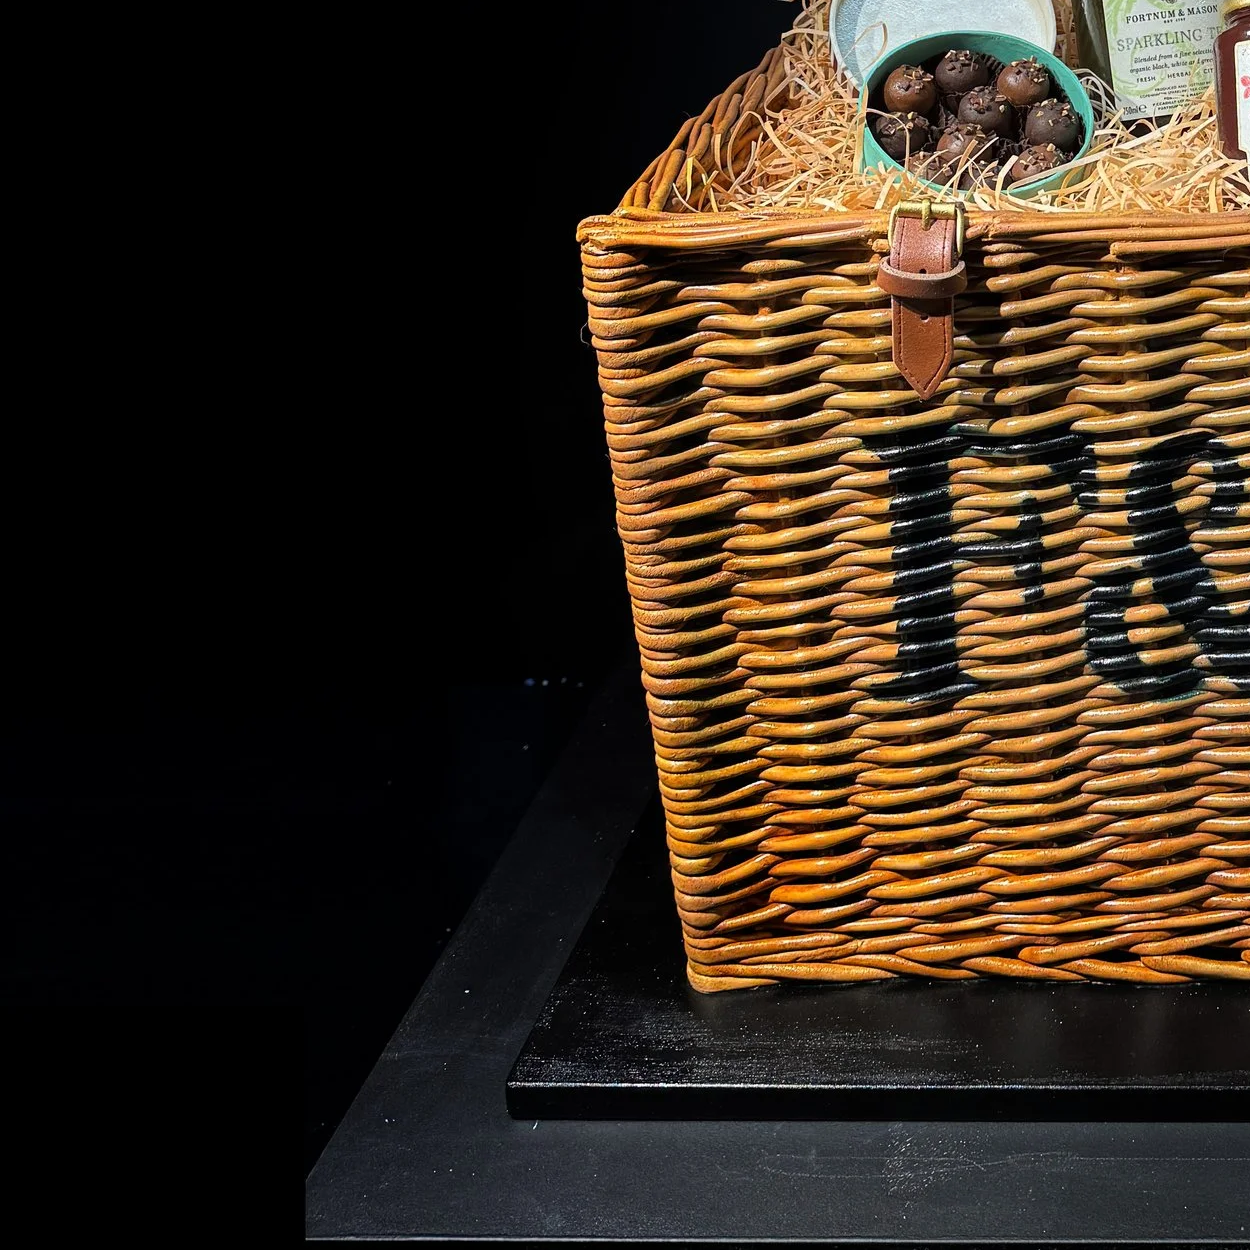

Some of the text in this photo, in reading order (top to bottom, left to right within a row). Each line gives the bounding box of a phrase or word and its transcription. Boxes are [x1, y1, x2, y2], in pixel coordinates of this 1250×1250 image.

[1126, 10, 1176, 24] FORTNUM
[1178, 9, 1185, 17] &
[1187, 4, 1219, 16] MASON
[1116, 25, 1227, 52] SPARKLING TE
